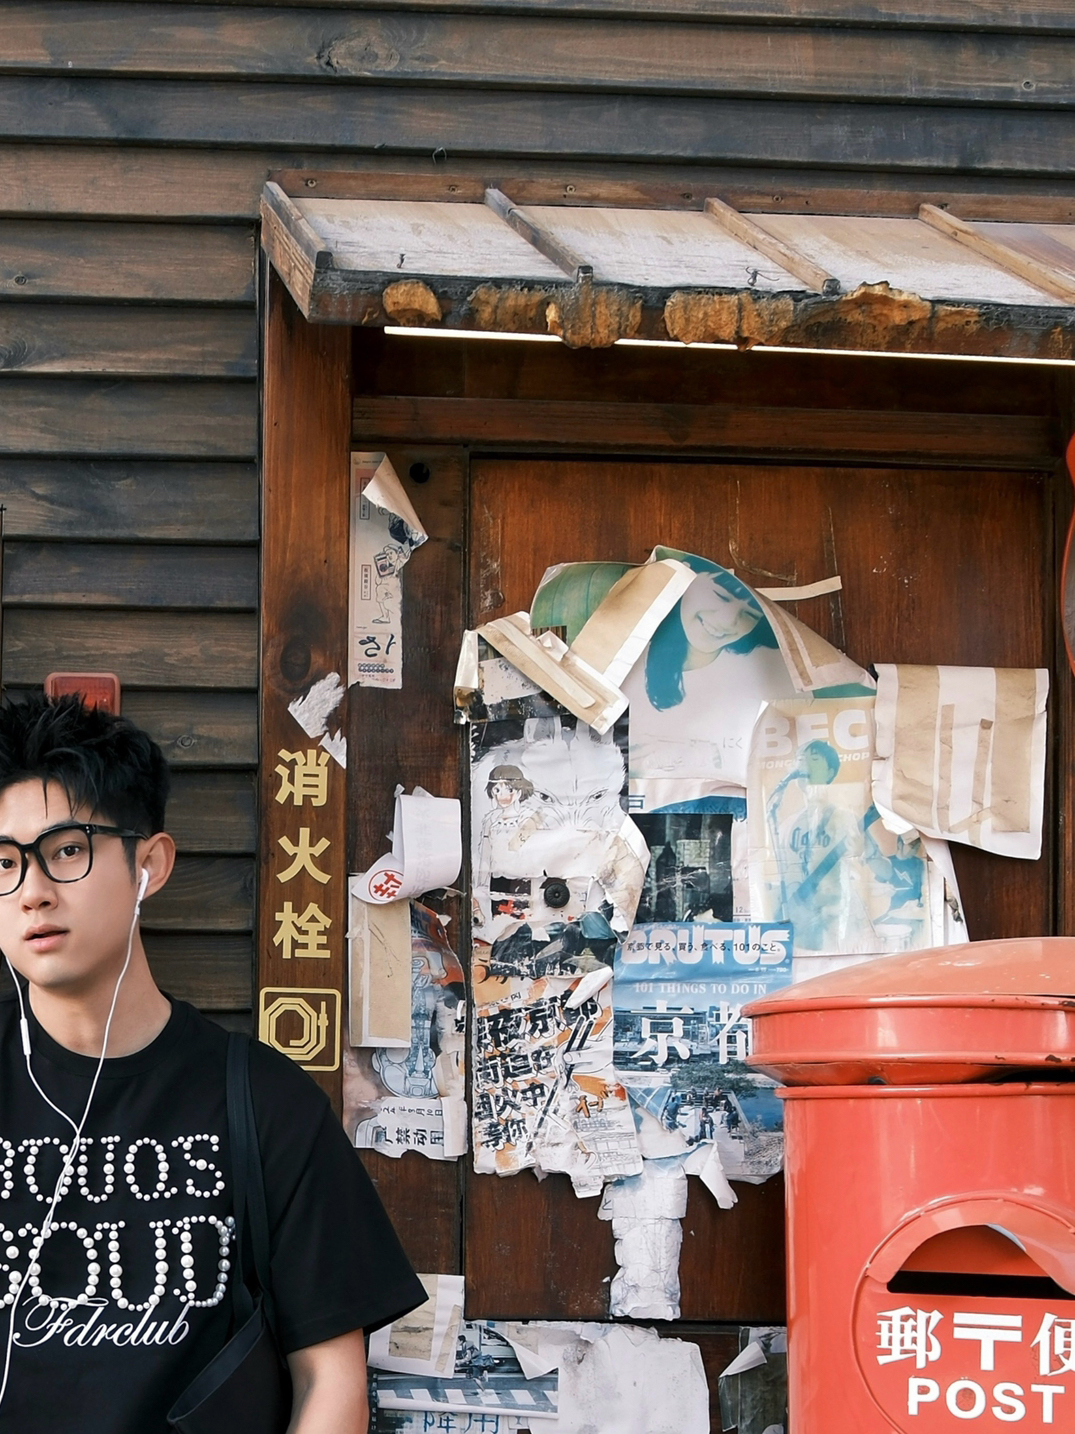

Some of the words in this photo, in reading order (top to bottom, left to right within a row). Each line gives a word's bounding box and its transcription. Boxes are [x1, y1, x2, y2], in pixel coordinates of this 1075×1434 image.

[272, 748, 333, 961] 消火栓
[621, 924, 792, 966] BRUTUS
[634, 982, 654, 993] 101
[659, 982, 707, 994] THINGS
[711, 983, 727, 994] TO
[731, 983, 750, 995] DO
[754, 983, 767, 995] IN
[906, 1376, 1066, 1424] POST
